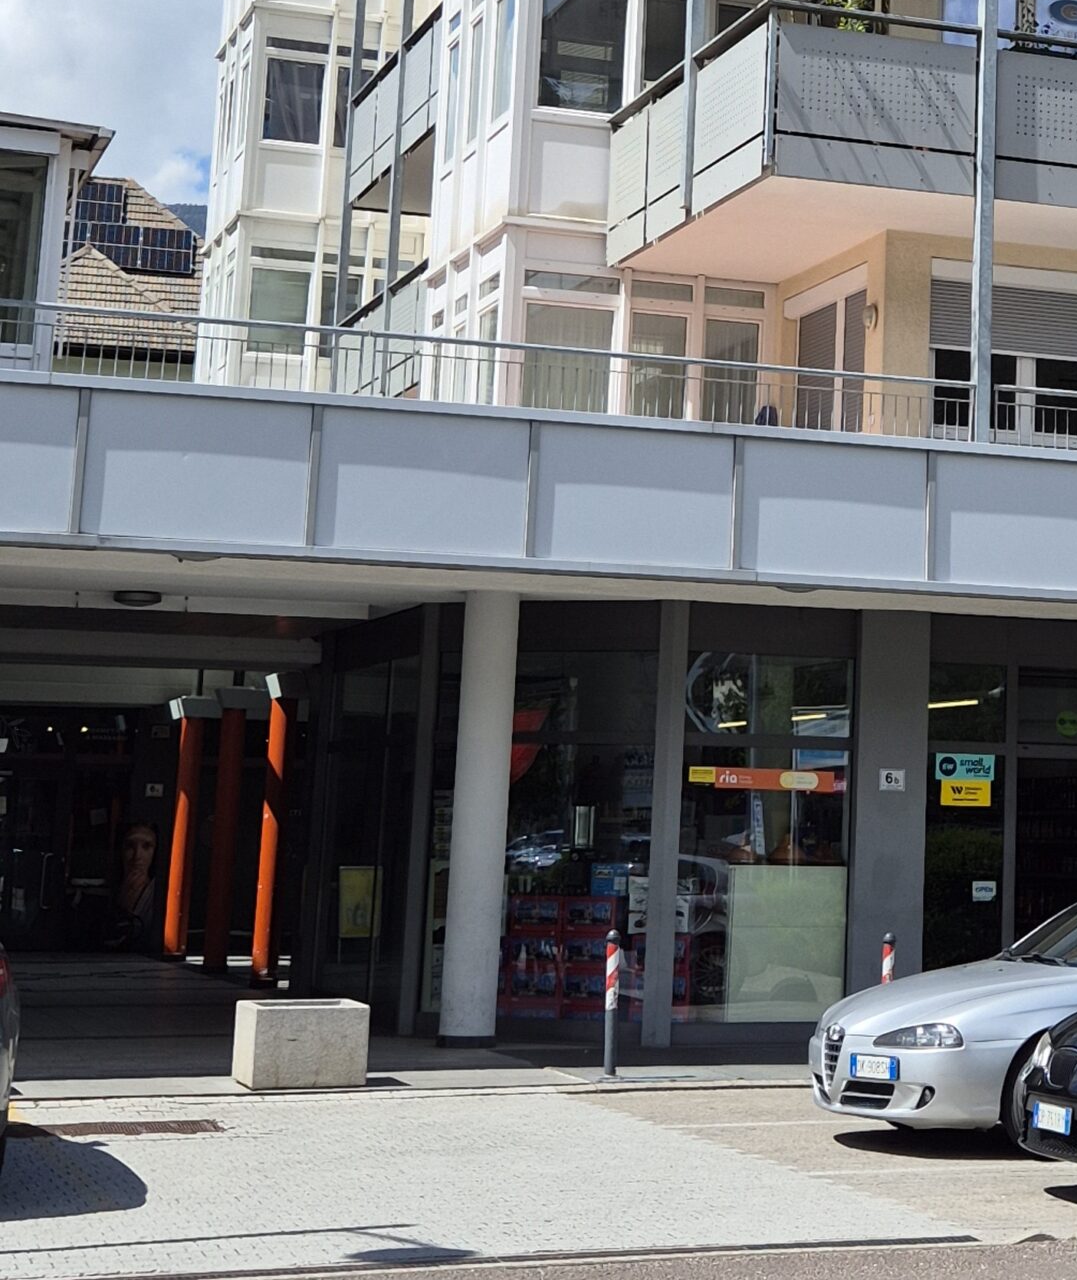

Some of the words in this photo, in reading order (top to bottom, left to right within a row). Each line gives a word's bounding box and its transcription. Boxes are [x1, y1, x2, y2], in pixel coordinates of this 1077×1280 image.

[965, 765, 992, 775] world
[719, 770, 738, 784] ria
[885, 772, 900, 785] 6b
